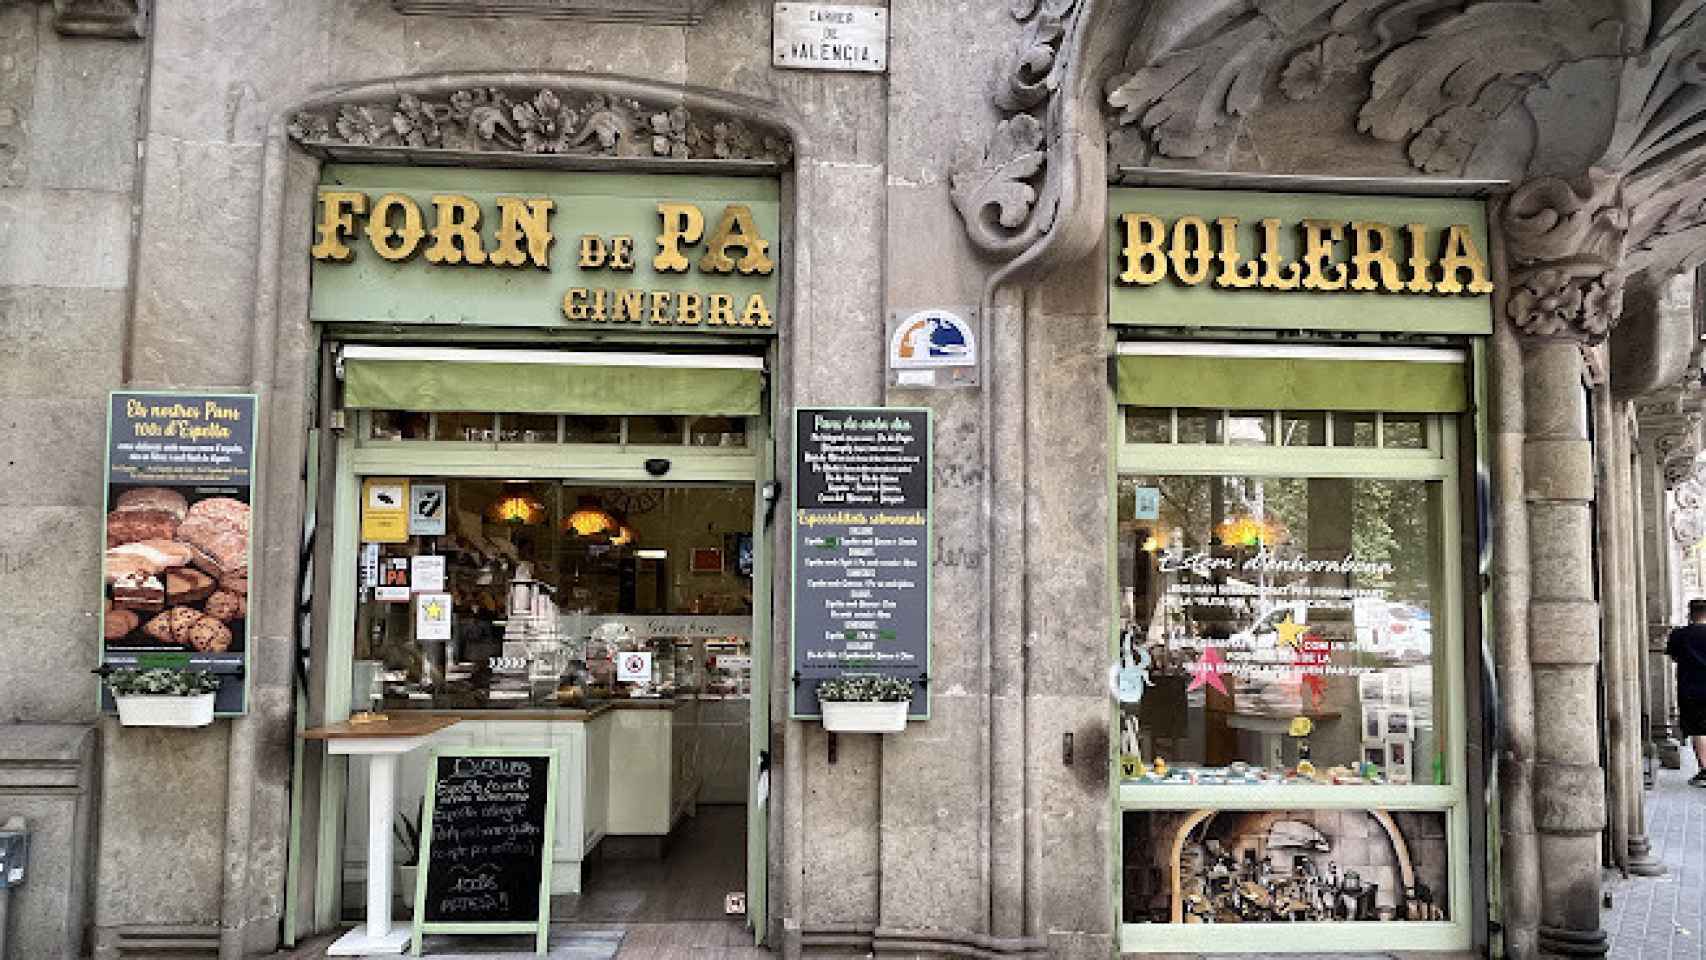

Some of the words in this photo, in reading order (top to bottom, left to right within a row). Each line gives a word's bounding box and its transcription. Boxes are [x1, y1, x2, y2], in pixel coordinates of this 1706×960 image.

[311, 192, 554, 271] FORN
[577, 234, 635, 271] DE
[652, 202, 775, 274] PA
[1119, 212, 1494, 294] BOLLERIA
[562, 287, 773, 328] GINEBRA
